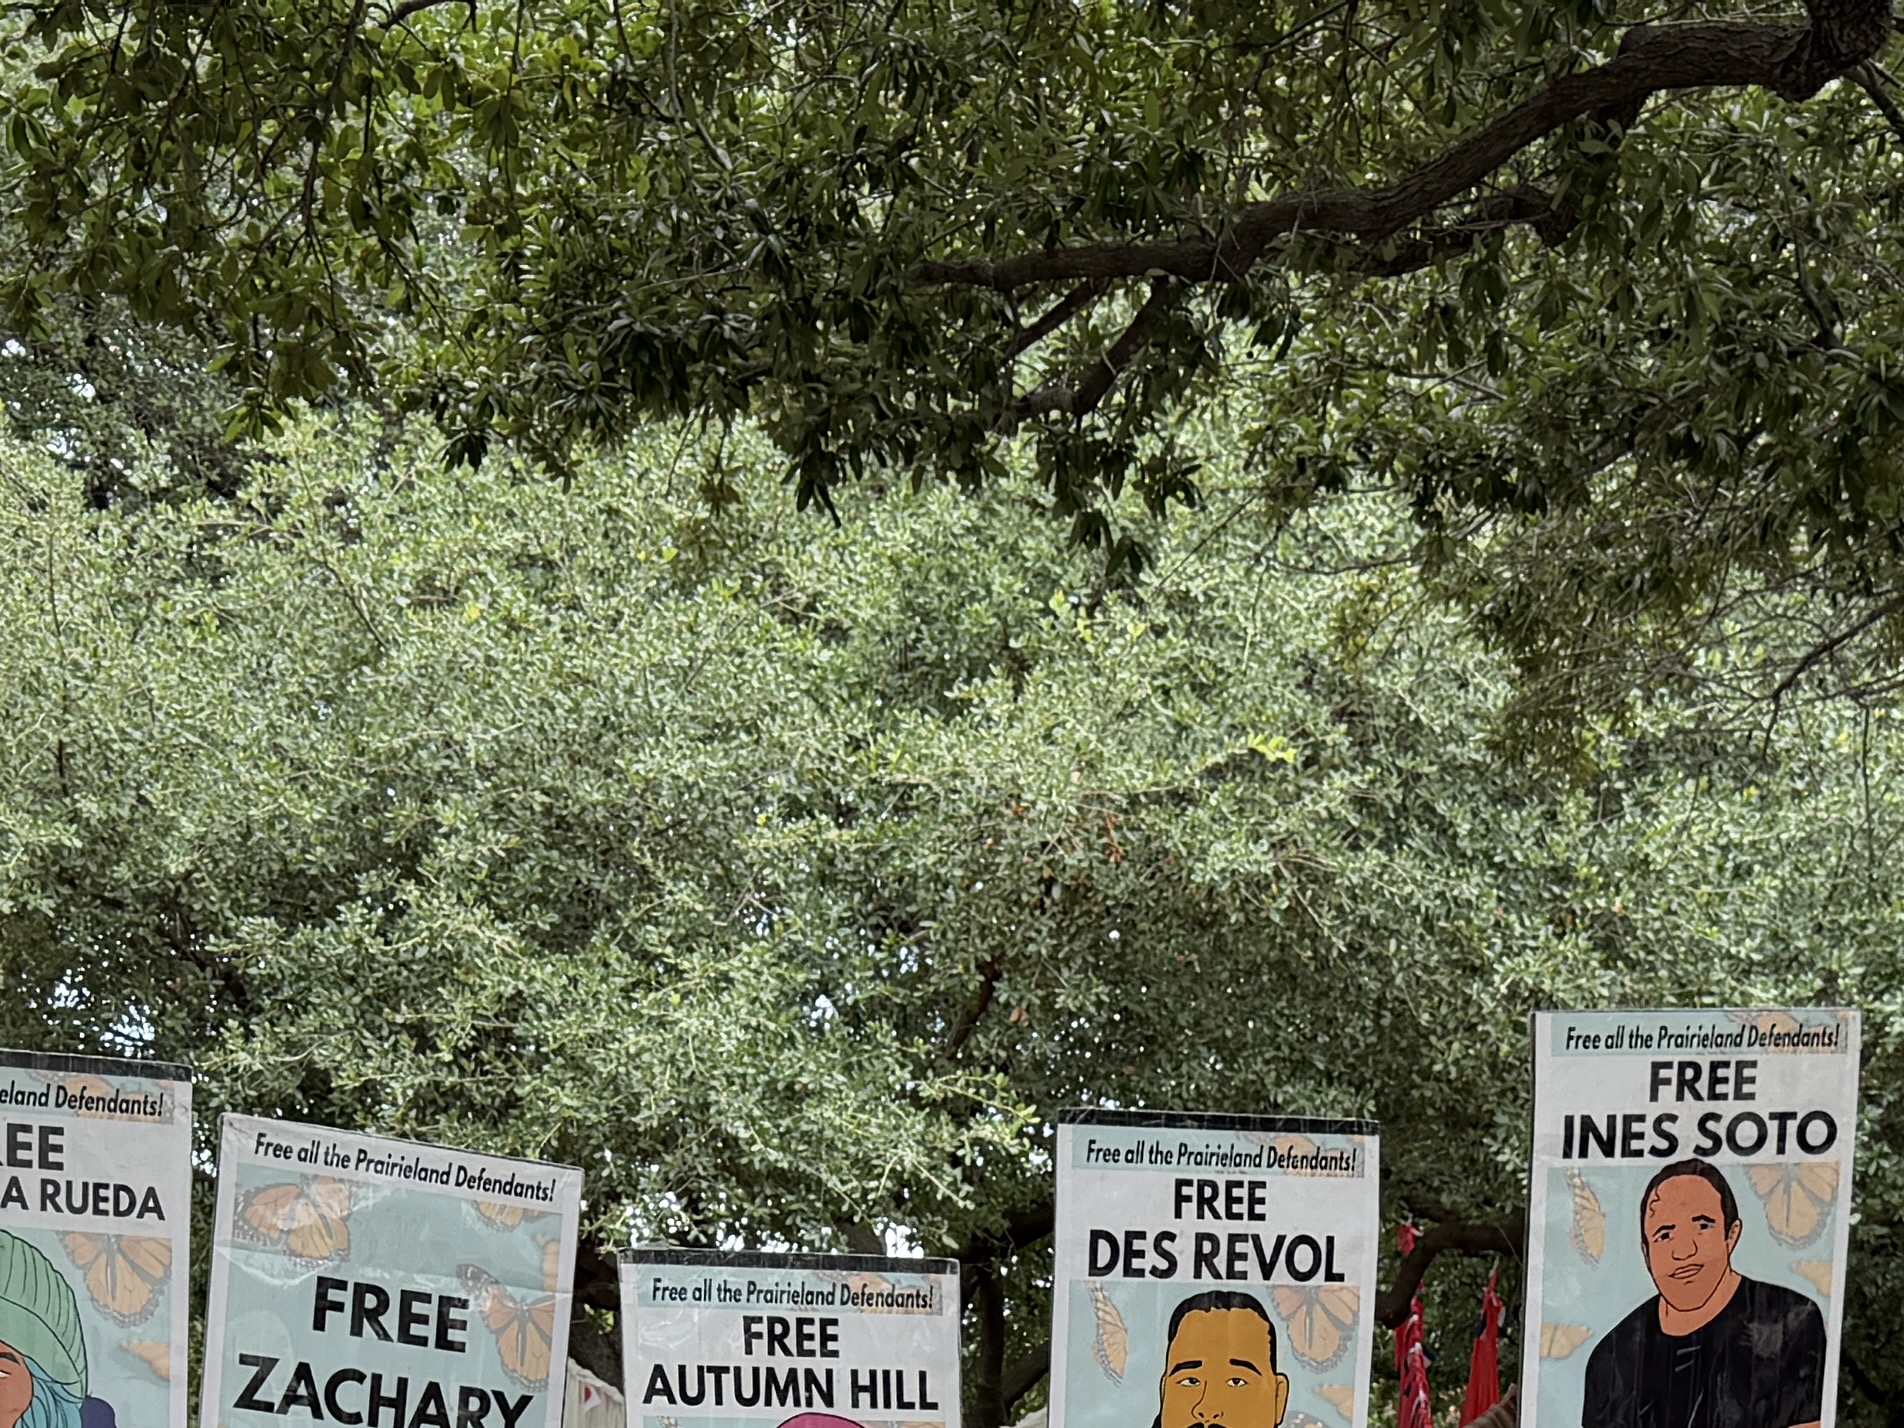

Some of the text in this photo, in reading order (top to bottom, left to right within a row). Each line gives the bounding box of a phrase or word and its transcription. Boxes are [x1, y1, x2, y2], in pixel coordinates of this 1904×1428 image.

[1566, 1023, 1839, 1050] Free all the Prairieland Defendants!
[54, 1085, 163, 1117] Defendants!
[1649, 1060, 1758, 1102] FREE
[1086, 1139, 1356, 1171] Free all the Prairieland Defendants!
[1562, 1110, 1837, 1159] INES SOTO
[254, 1133, 555, 1202] Free all the Prairieland Defendants!
[40, 1178, 165, 1220] RUEDA
[1174, 1178, 1266, 1222] FREE
[1088, 1229, 1345, 1283] DES REVOL
[312, 1276, 470, 1354] FREE
[652, 1278, 934, 1309] Free all the Prairieland Defendants!
[742, 1315, 839, 1358] FREE
[643, 1364, 939, 1410] AUTUMN HILL
